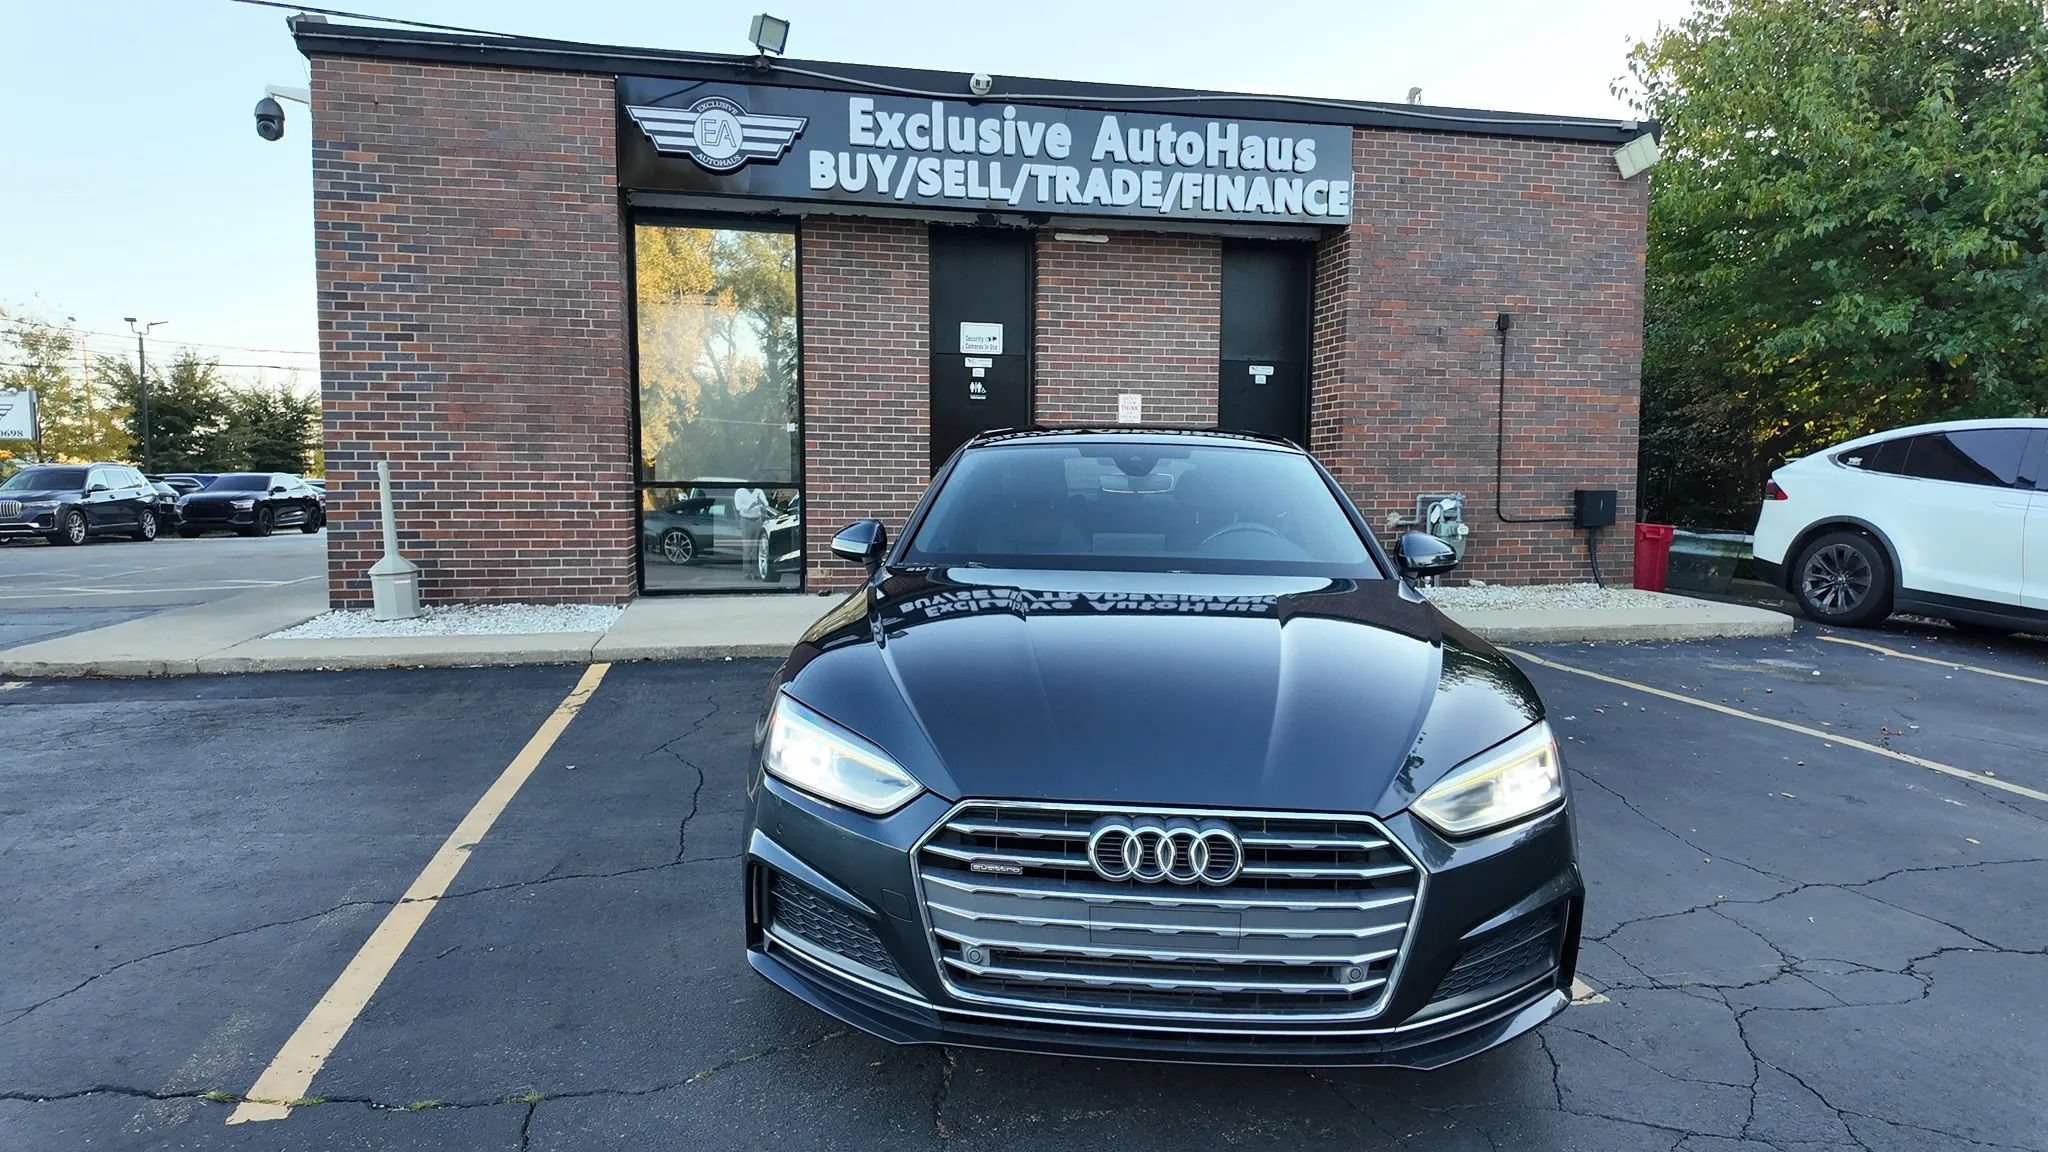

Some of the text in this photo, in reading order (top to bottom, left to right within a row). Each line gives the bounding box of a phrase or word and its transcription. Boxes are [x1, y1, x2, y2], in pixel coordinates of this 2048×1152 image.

[697, 101, 739, 115] EXCLUSIVE
[701, 119, 737, 148] EA
[849, 97, 1317, 172] Exclusive AutoHaus
[696, 153, 742, 167] AUTOHAUS
[809, 150, 1349, 216] BUY/SELL/TRADE/FINANCE
[965, 335, 984, 343] Security
